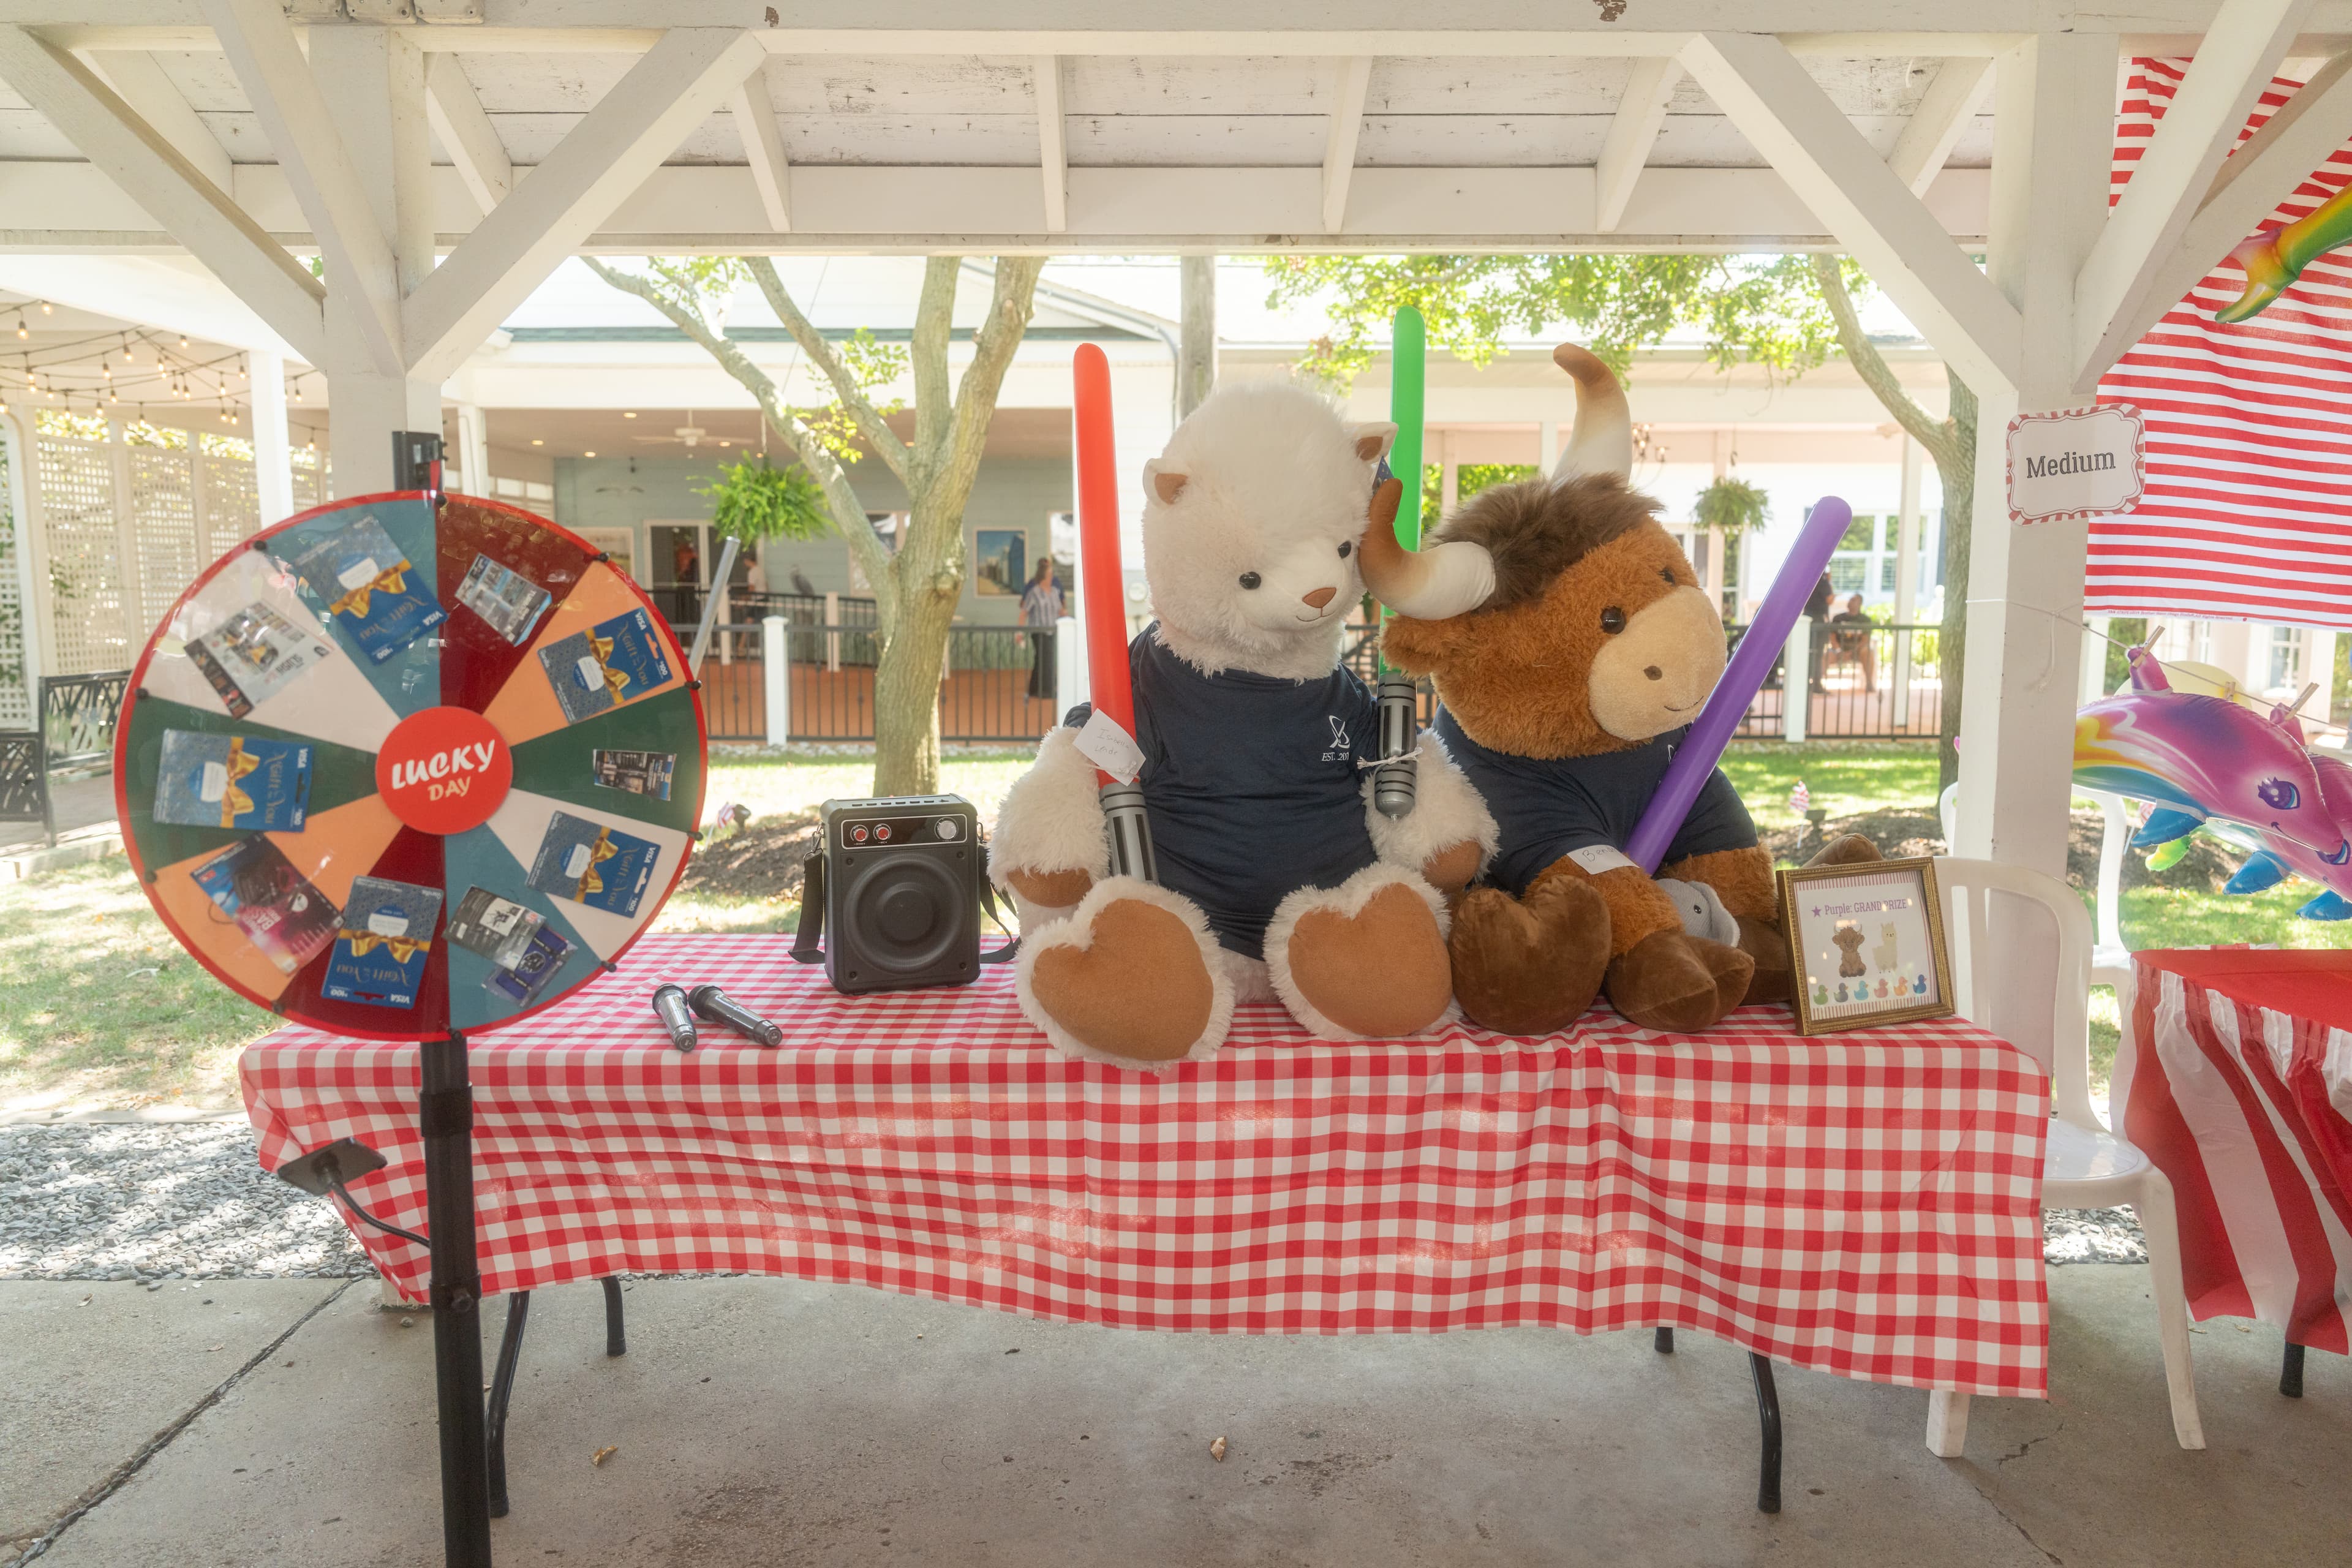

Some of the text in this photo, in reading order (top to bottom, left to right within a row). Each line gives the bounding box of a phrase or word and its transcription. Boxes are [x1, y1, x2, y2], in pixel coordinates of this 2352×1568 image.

[2026, 451, 2116, 478] Medium
[635, 611, 647, 630] VISA
[392, 739, 495, 790] LUCKY
[1322, 752, 1349, 761] EST. 201
[428, 776, 470, 801] DAY
[644, 847, 656, 863] VISA
[1824, 899, 1907, 916] Purple: GRAND PRIZE
[390, 993, 410, 1004] VISA
